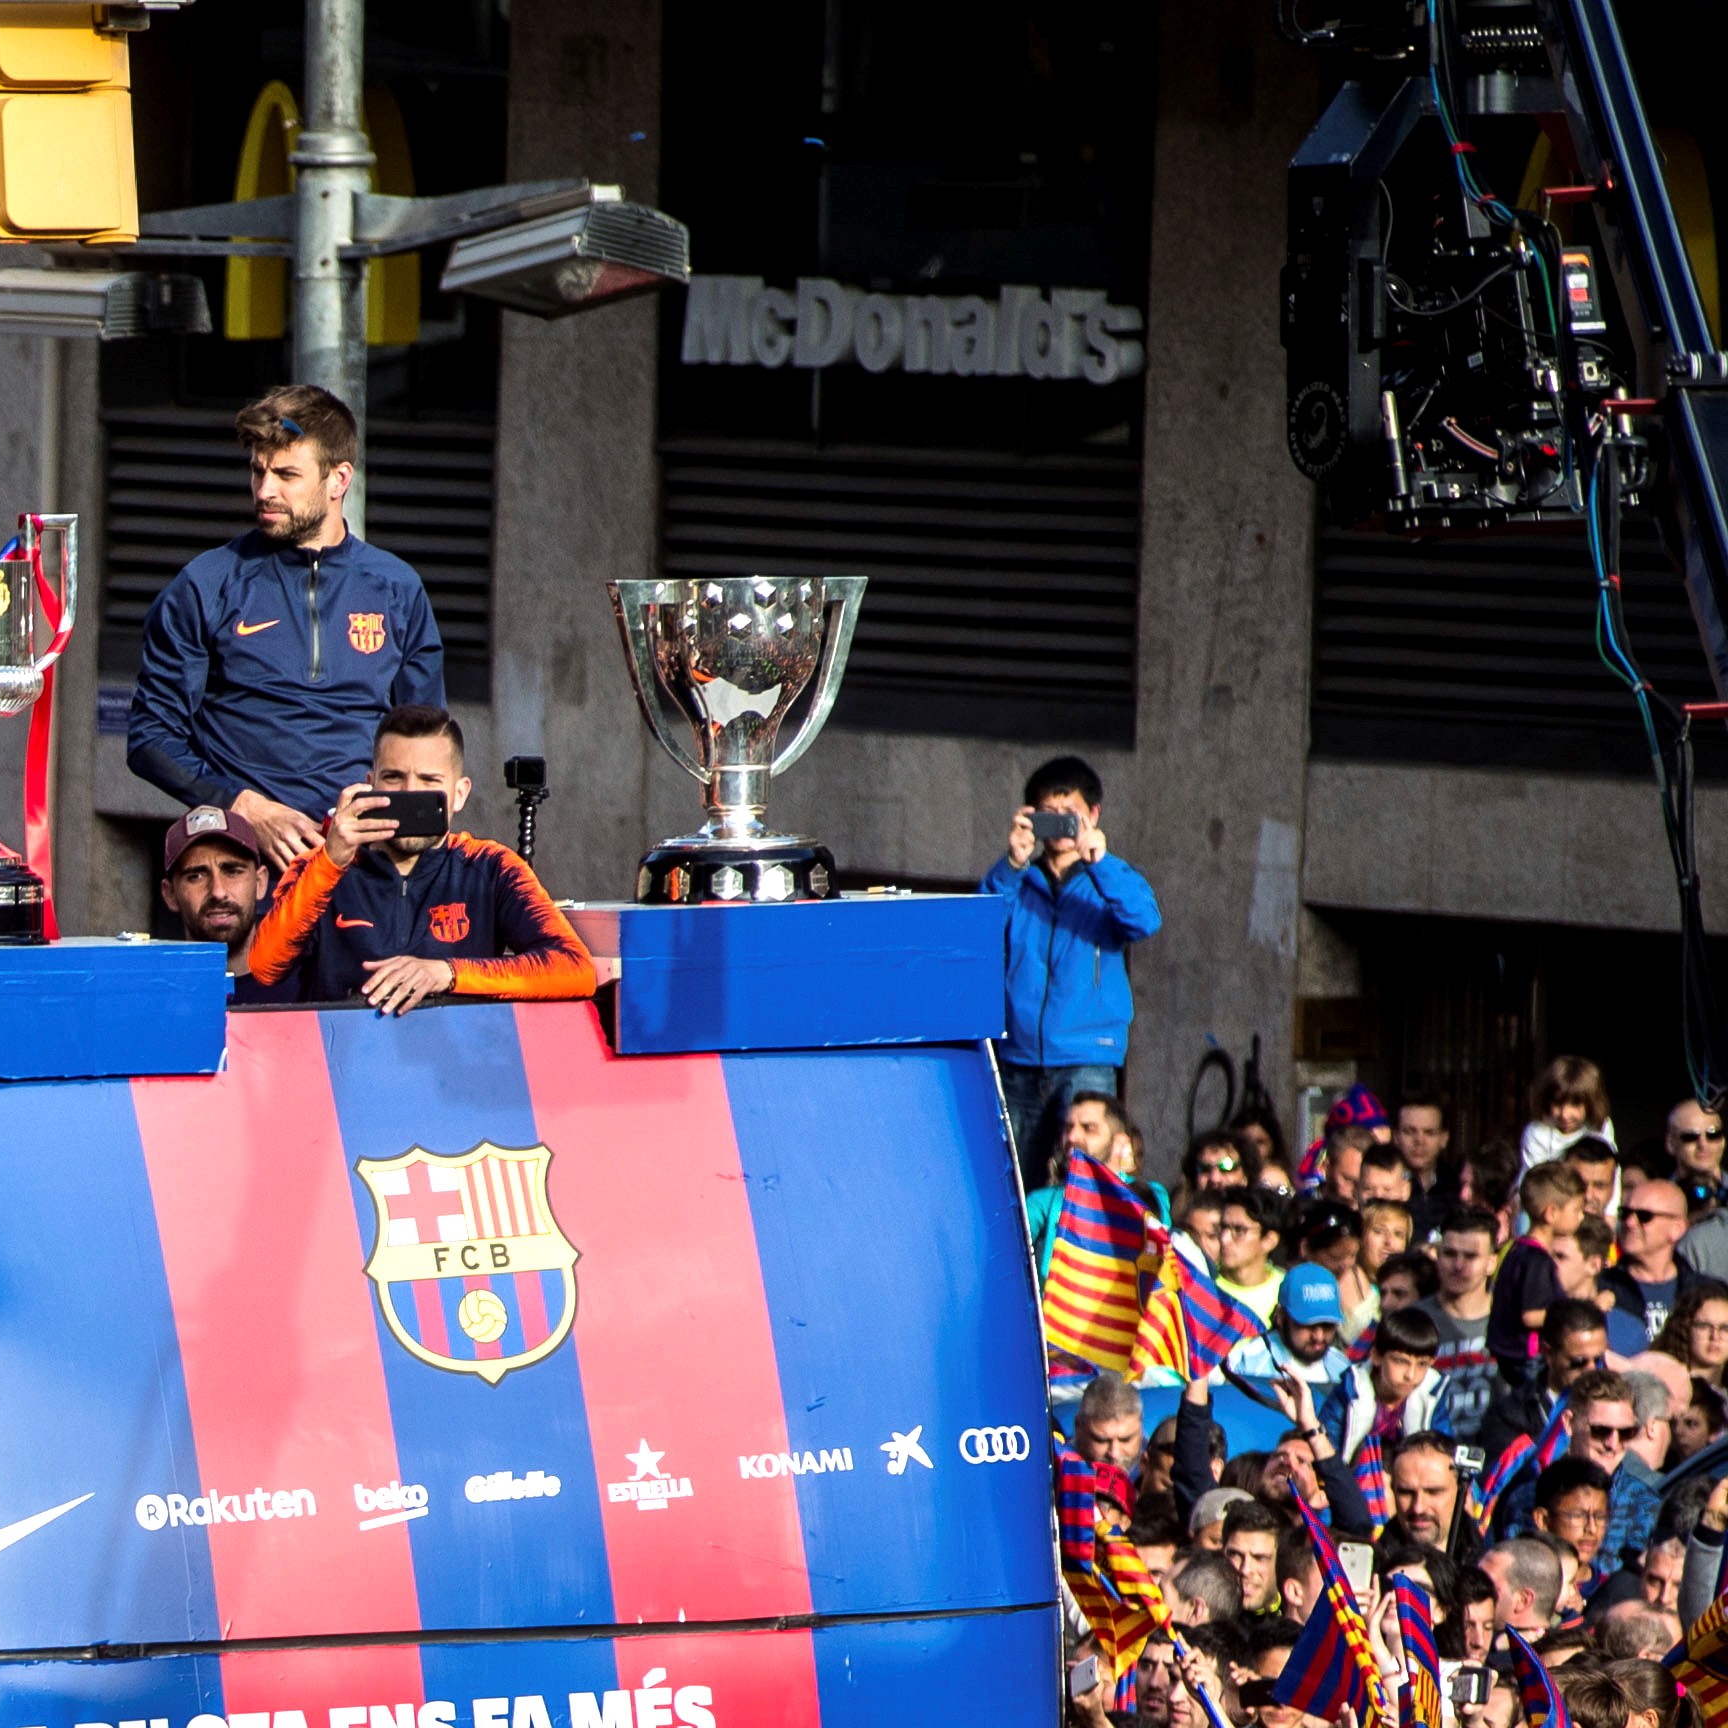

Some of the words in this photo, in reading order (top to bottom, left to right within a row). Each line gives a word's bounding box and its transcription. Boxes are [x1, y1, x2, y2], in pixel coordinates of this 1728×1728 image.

[681, 273, 1146, 384] McDonald's
[433, 1242, 511, 1272] FCB
[737, 1447, 854, 1480] KONAMI
[354, 1482, 429, 1513] beko
[607, 1477, 694, 1503] ESTRELLA
[170, 1485, 317, 1528] Rakuten
